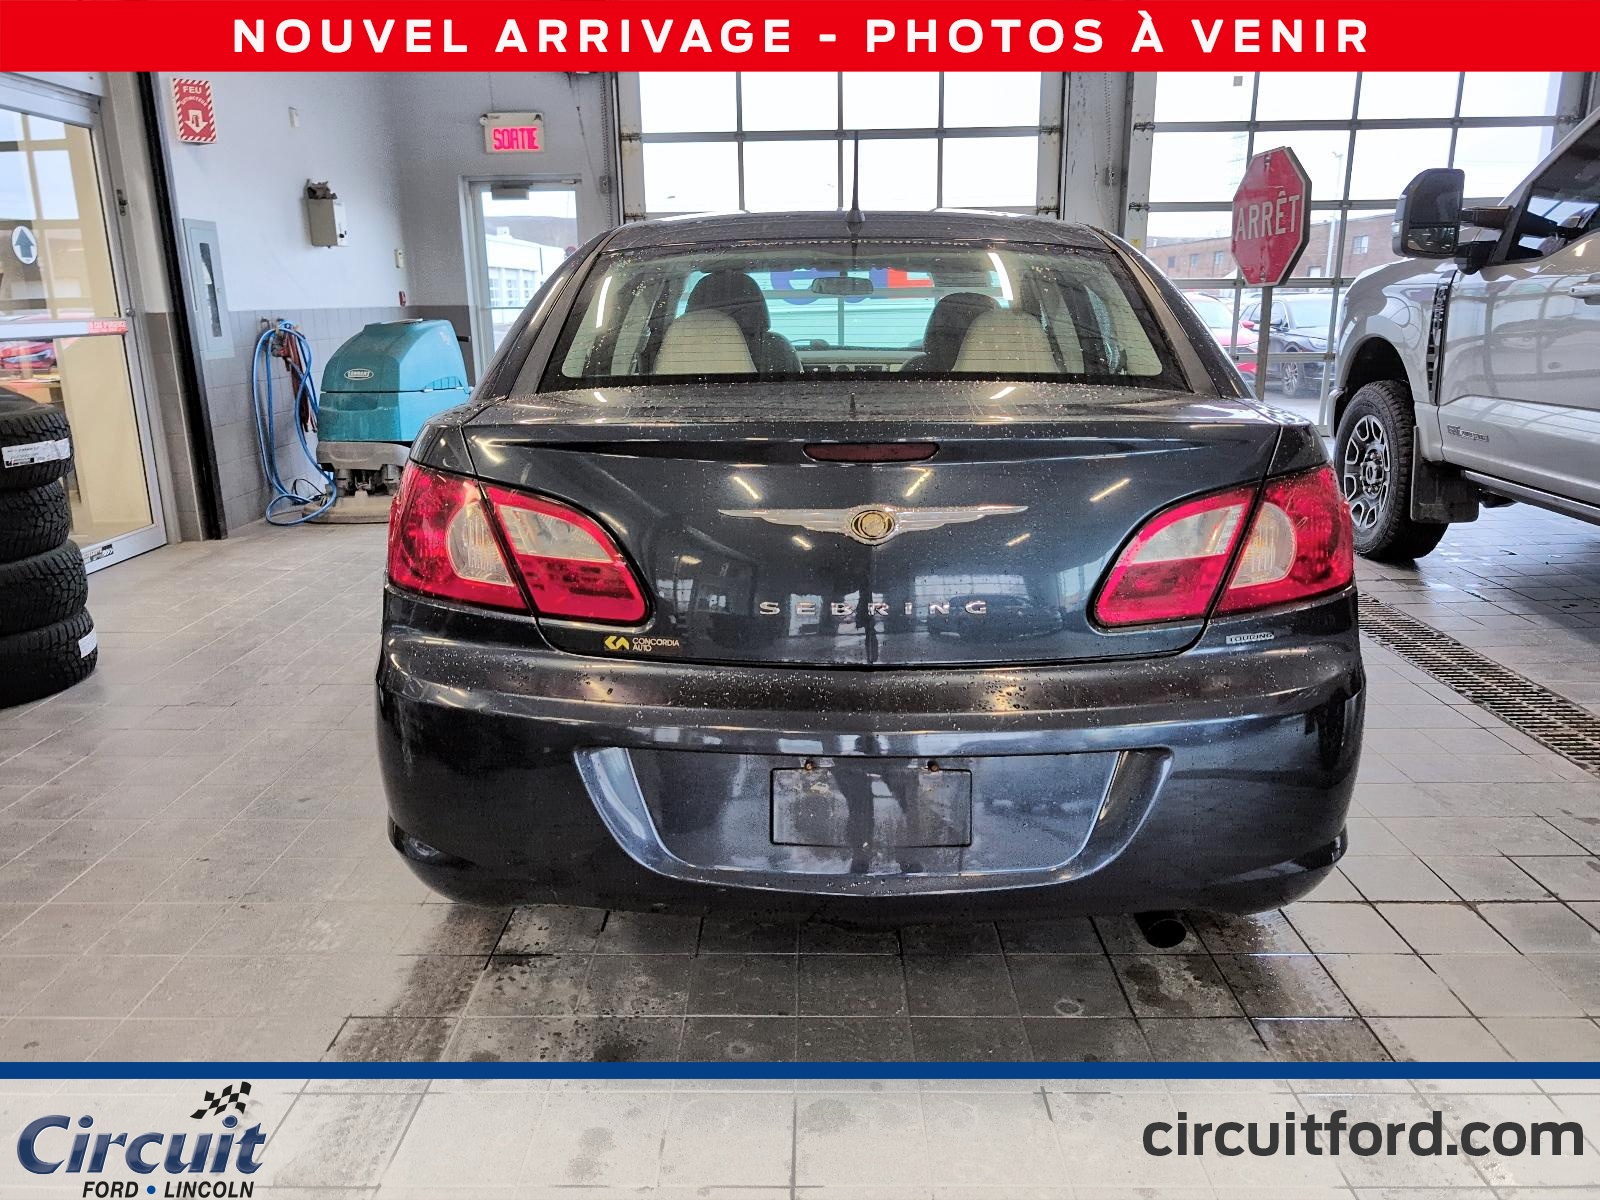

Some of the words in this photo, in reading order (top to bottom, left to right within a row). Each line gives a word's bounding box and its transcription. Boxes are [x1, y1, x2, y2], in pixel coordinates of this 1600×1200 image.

[182, 85, 202, 94] FEU
[493, 127, 540, 150] SORTIE
[1234, 190, 1301, 242] ARRÊT
[759, 600, 987, 616] SEBRING
[632, 637, 680, 647] CONCORDIA
[1228, 632, 1273, 643] TOURING
[632, 644, 653, 652] AUTO
